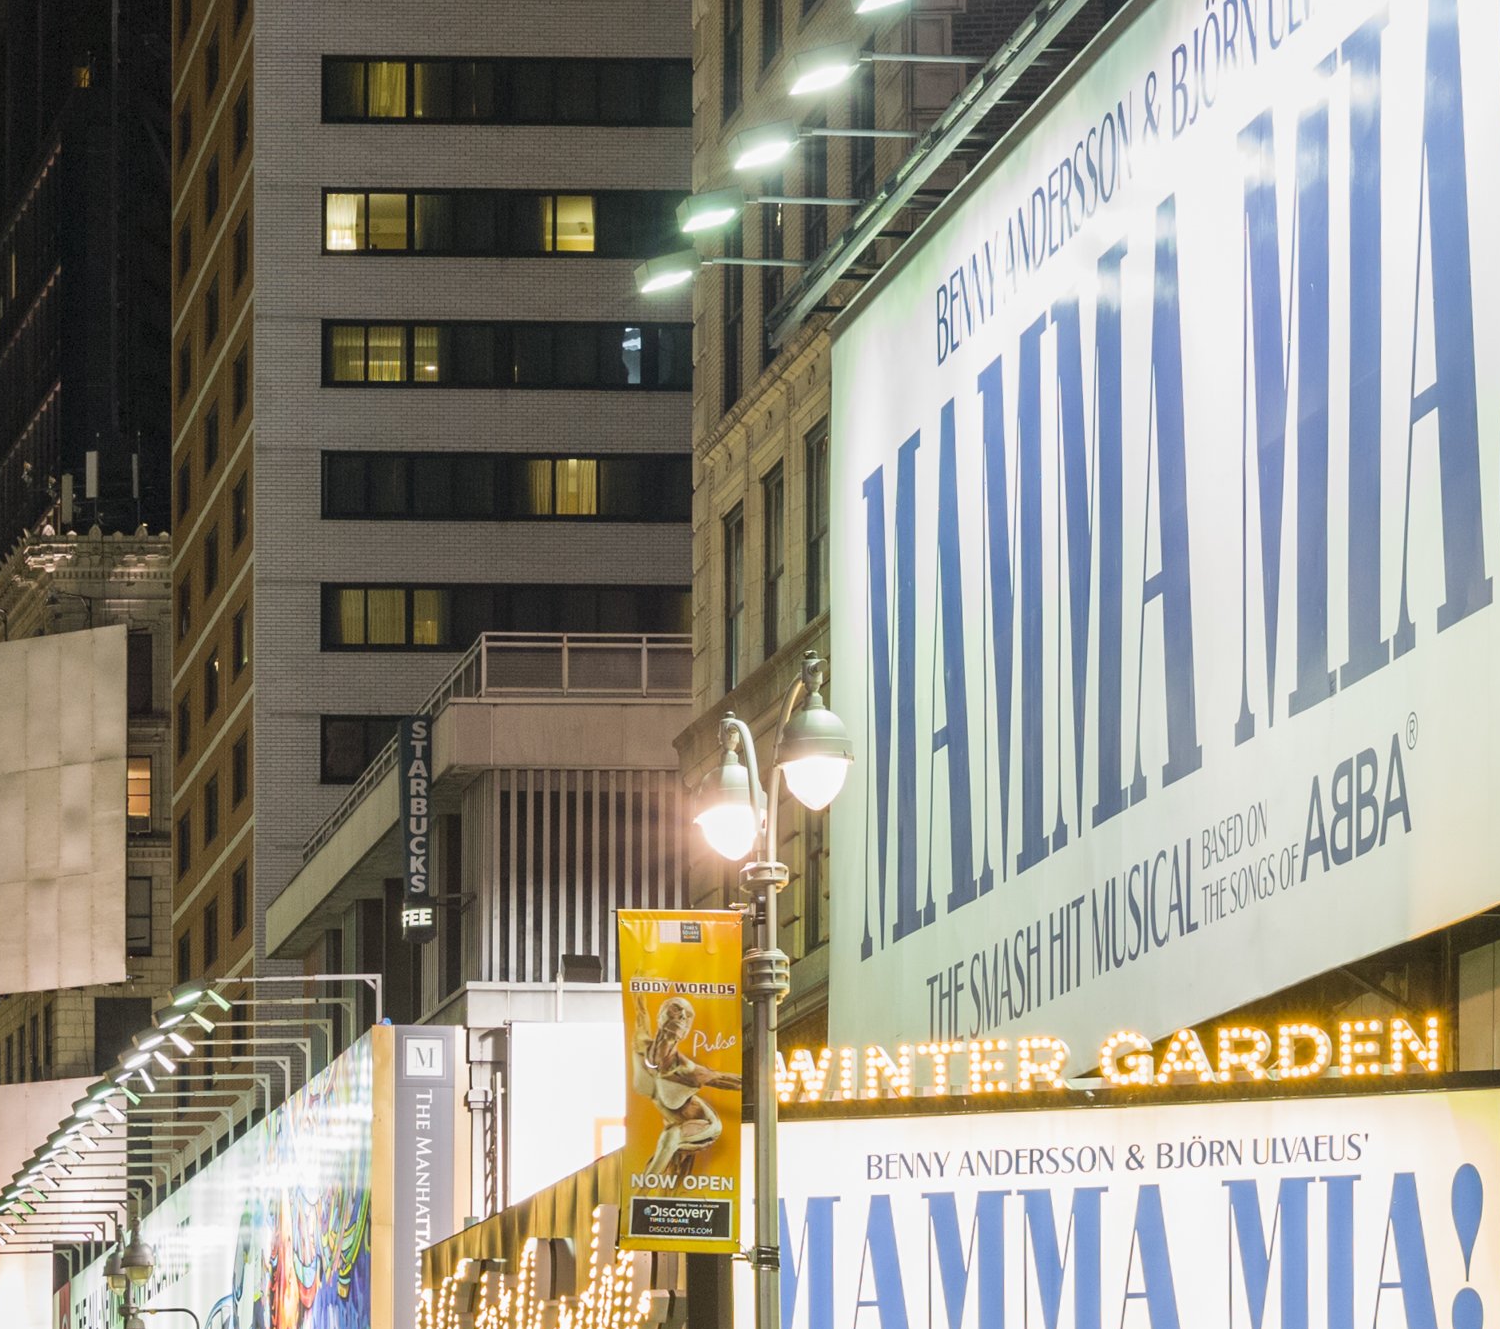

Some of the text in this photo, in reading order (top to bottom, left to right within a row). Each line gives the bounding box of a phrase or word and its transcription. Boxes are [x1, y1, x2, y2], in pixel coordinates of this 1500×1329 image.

[936, 231, 998, 367] BENNY
[1004, 91, 1133, 305] ANDERSSON
[861, 192, 1204, 961] MAMMA
[407, 721, 428, 893] STARBUCKS
[1201, 801, 1269, 870] BASED ON
[1201, 843, 1299, 926] THE SONGS OF
[926, 838, 1199, 1043] THE SMASH HIT MUSICAL
[630, 981, 736, 995] BODY WORLDS
[693, 1030, 737, 1058] Pulse
[775, 1016, 1441, 1103] WINTER GARDEN
[416, 1089, 432, 1129] THE
[631, 1174, 734, 1191] NOW OPEN
[866, 1130, 1370, 1181] BENNY ANDERSSON & BJÖRN ULVAEUS'
[649, 1204, 713, 1222] Discovery
